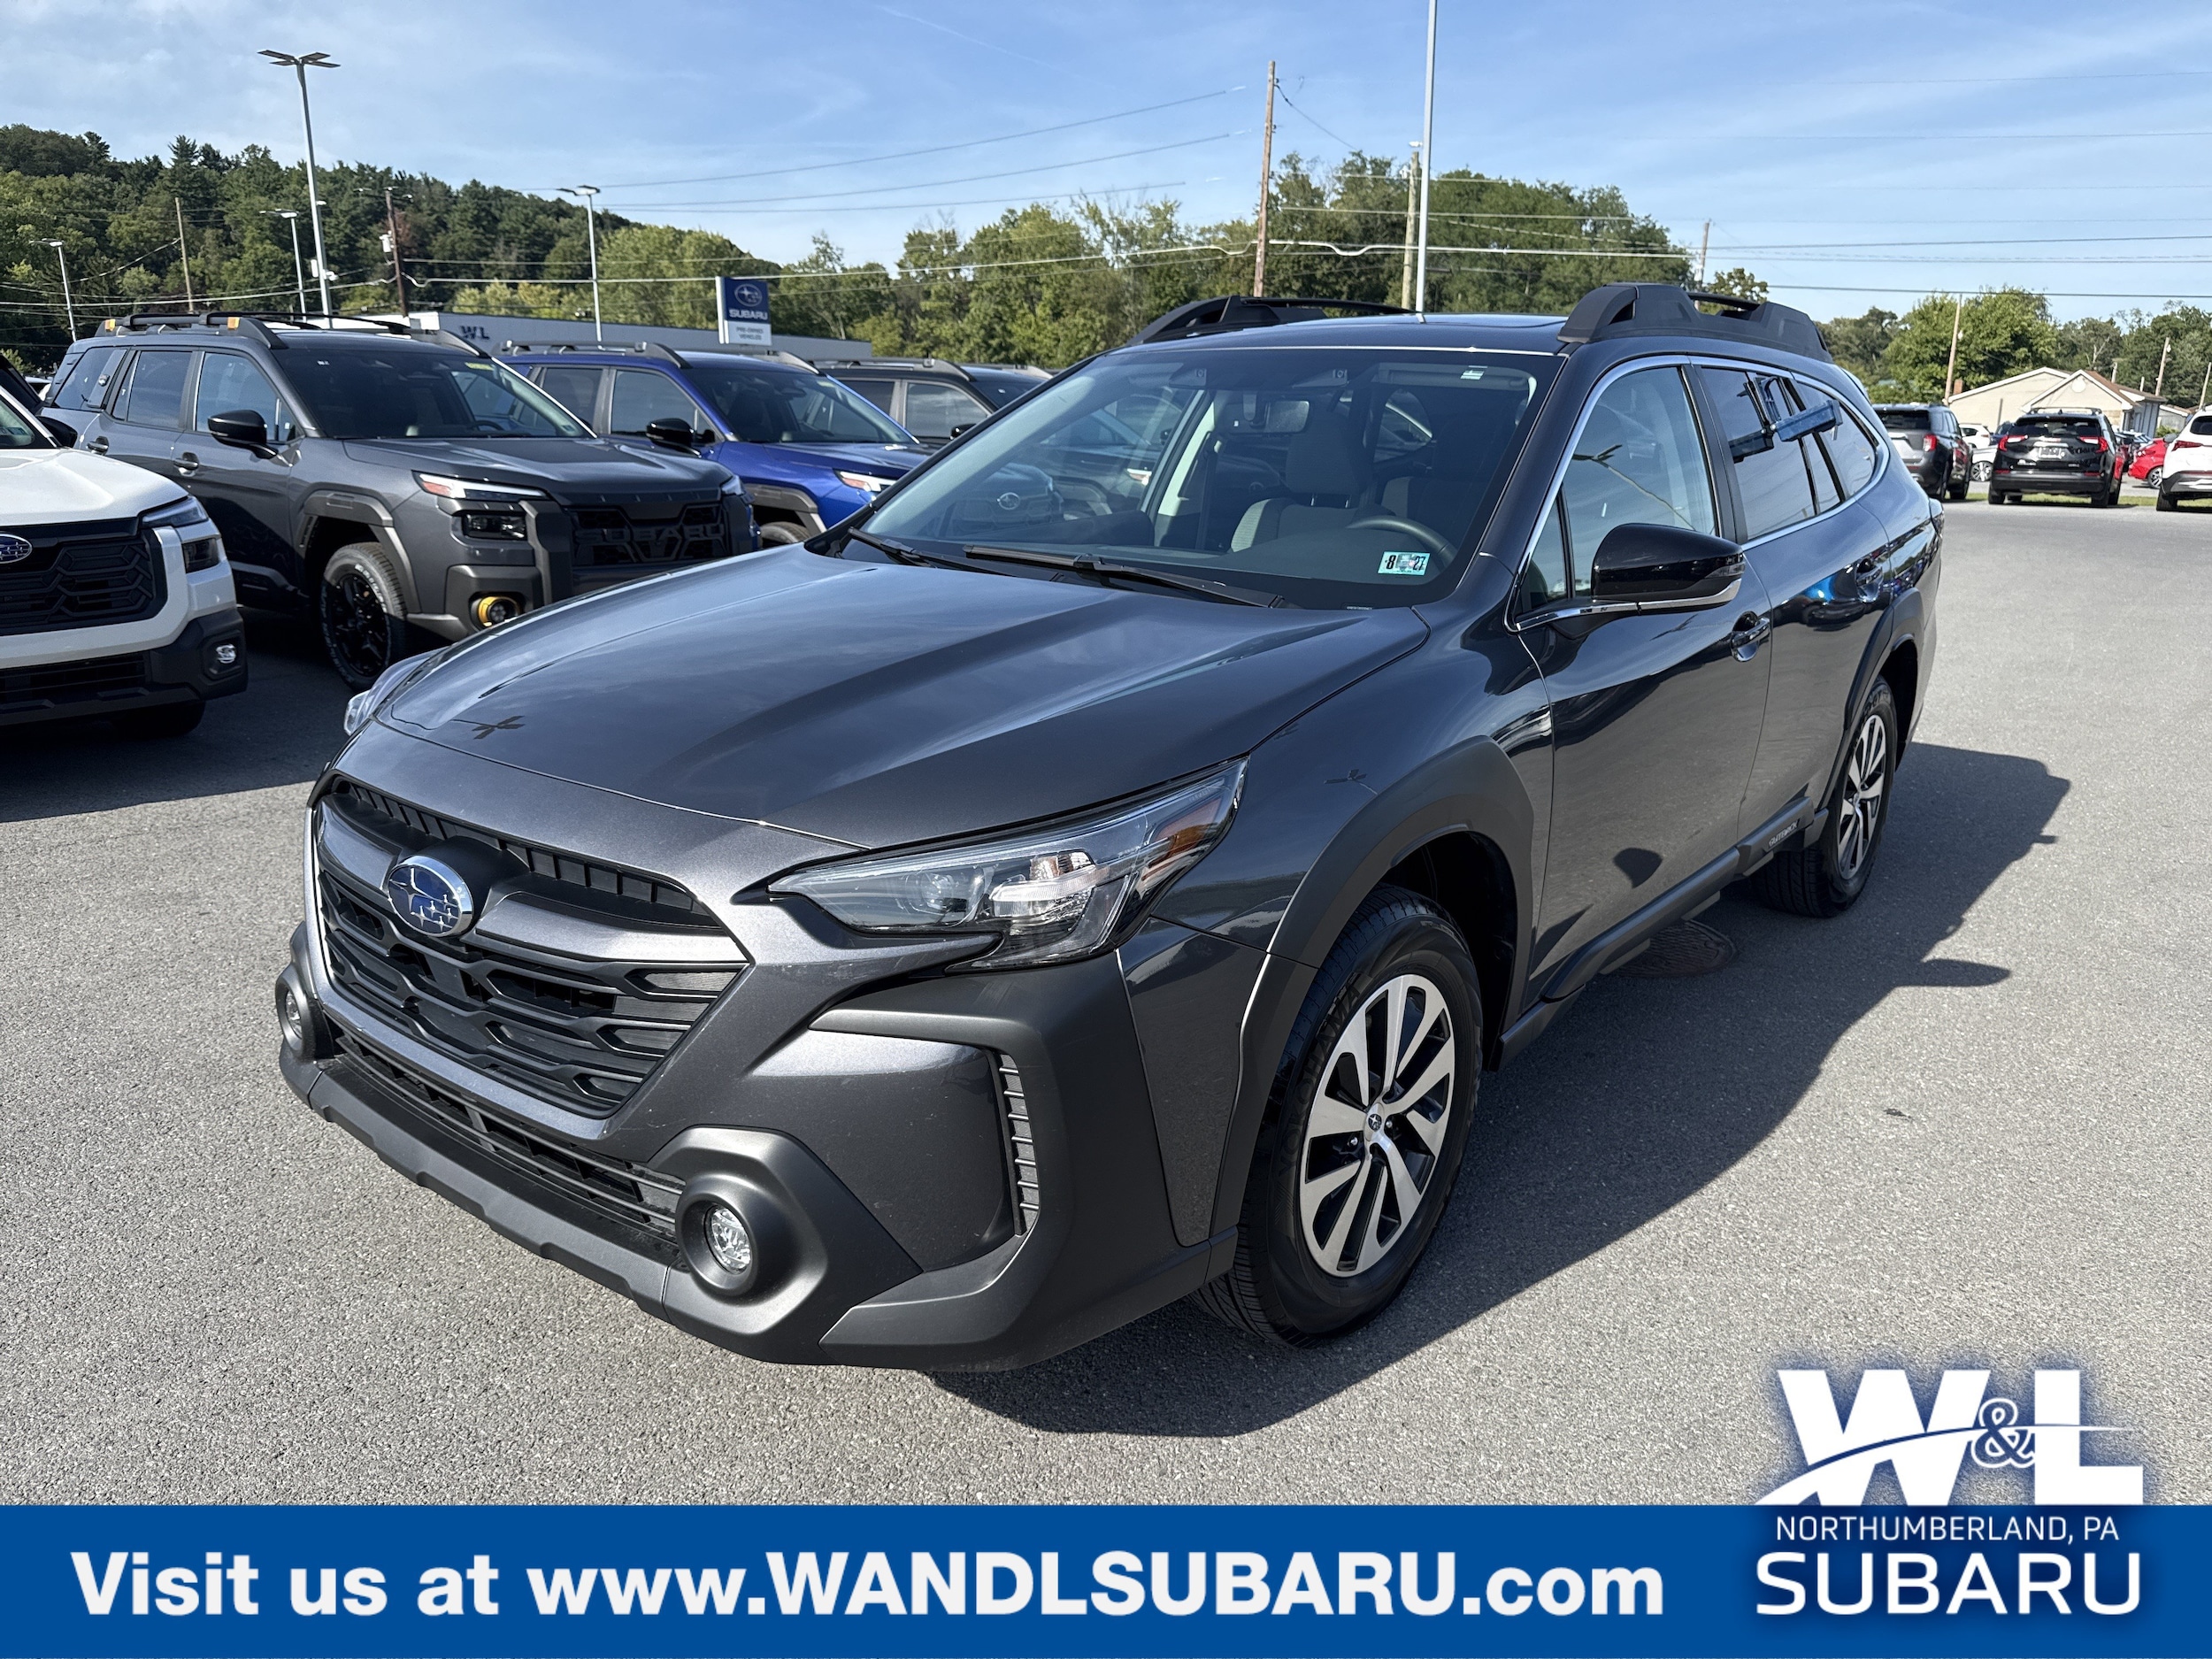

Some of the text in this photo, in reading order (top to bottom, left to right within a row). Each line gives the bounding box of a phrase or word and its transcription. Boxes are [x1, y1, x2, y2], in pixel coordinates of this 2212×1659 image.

[728, 309, 768, 320] SUBARU
[575, 524, 725, 544] SUBARU
[1413, 556, 1426, 571] 27
[1279, 980, 1360, 1177] YOKOHAMA
